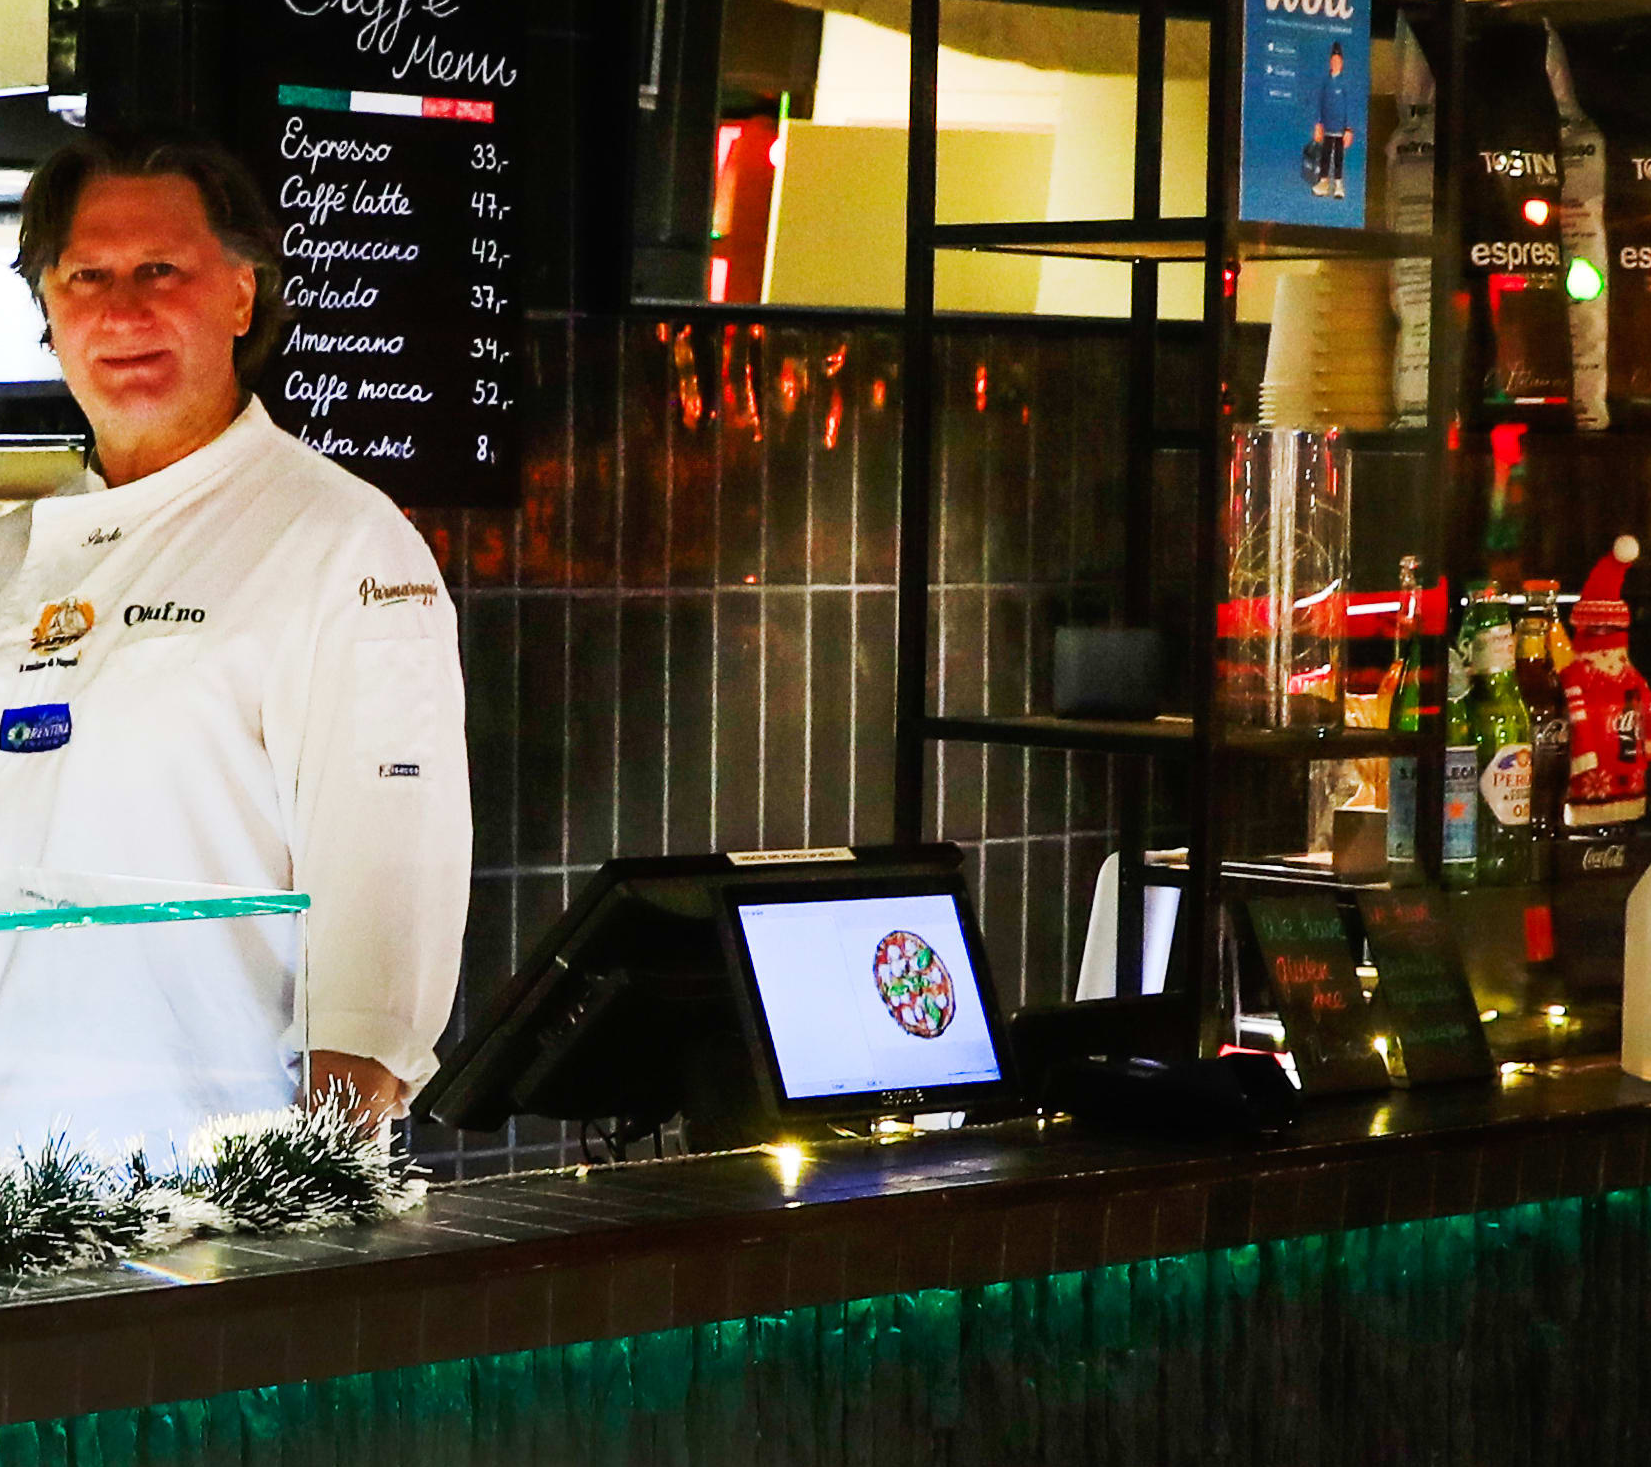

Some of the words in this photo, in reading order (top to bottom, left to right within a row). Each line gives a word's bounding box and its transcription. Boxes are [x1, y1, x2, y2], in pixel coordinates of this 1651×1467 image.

[392, 34, 517, 87] Menu
[280, 116, 393, 175] Espresso
[280, 175, 349, 225] Caffé
[352, 179, 414, 215] latte
[282, 223, 420, 273] Cappuccino
[282, 323, 405, 356] Americano
[284, 370, 348, 417] Caffe
[357, 379, 434, 403] mocca
[363, 435, 416, 459] shot
